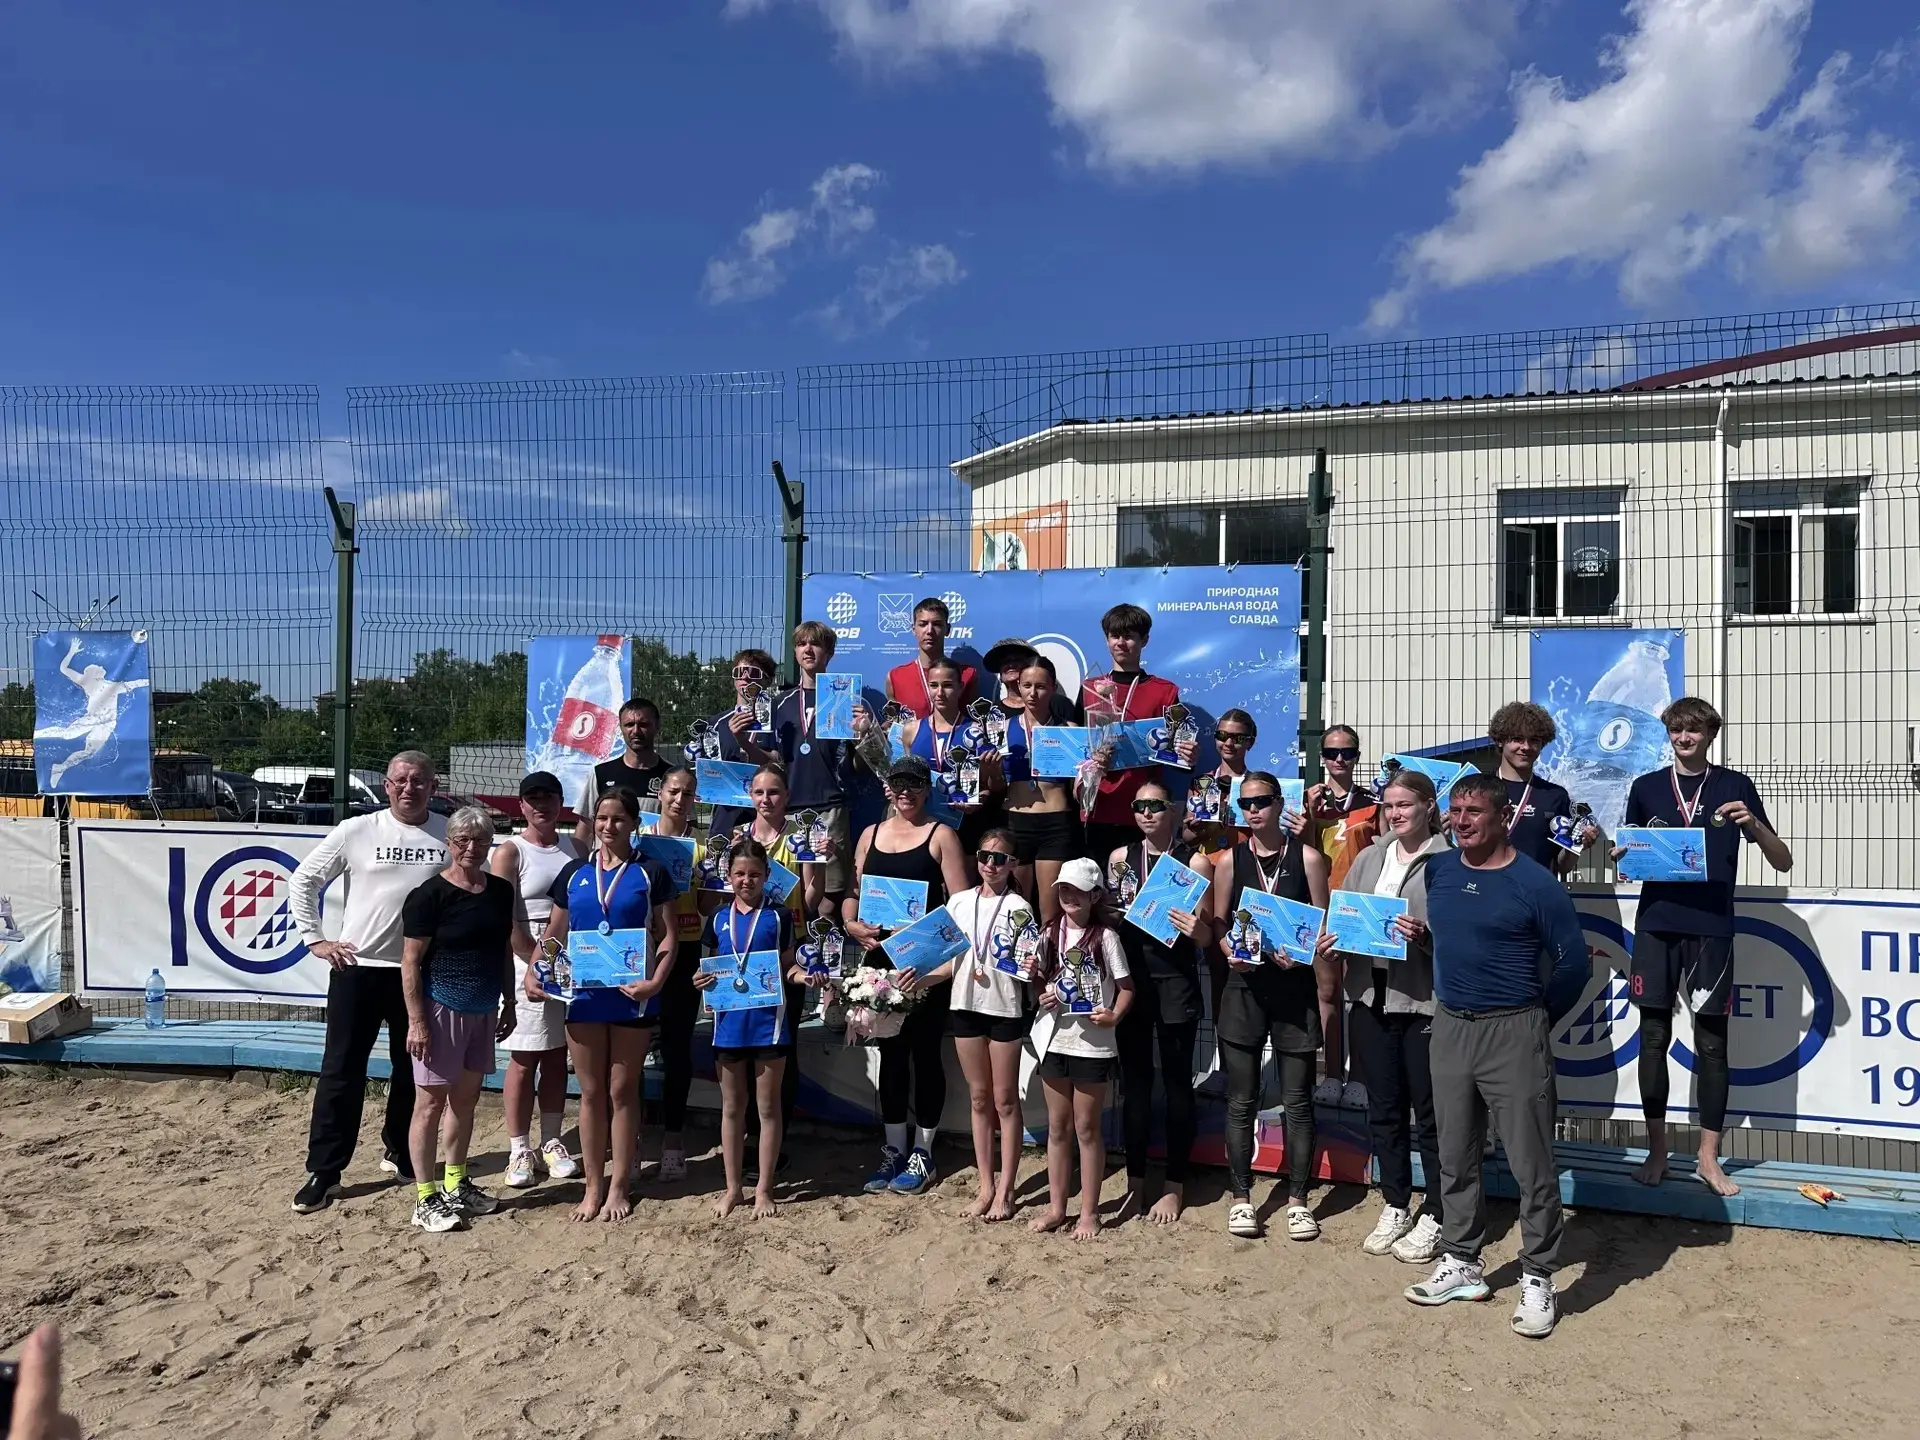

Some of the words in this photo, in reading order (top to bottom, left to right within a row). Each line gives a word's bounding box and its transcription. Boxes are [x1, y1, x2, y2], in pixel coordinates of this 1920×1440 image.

[1207, 587, 1279, 598] ПРИРОДНАЯ
[1157, 602, 1243, 612] МИНЕРАЛЬНАЯ
[1245, 601, 1279, 612] ВОДА
[1229, 615, 1279, 626] СЛАВДА
[0, 801, 18, 813] ТИ
[376, 847, 446, 862] LIBERTY
[1732, 984, 1783, 1019] ЕТ
